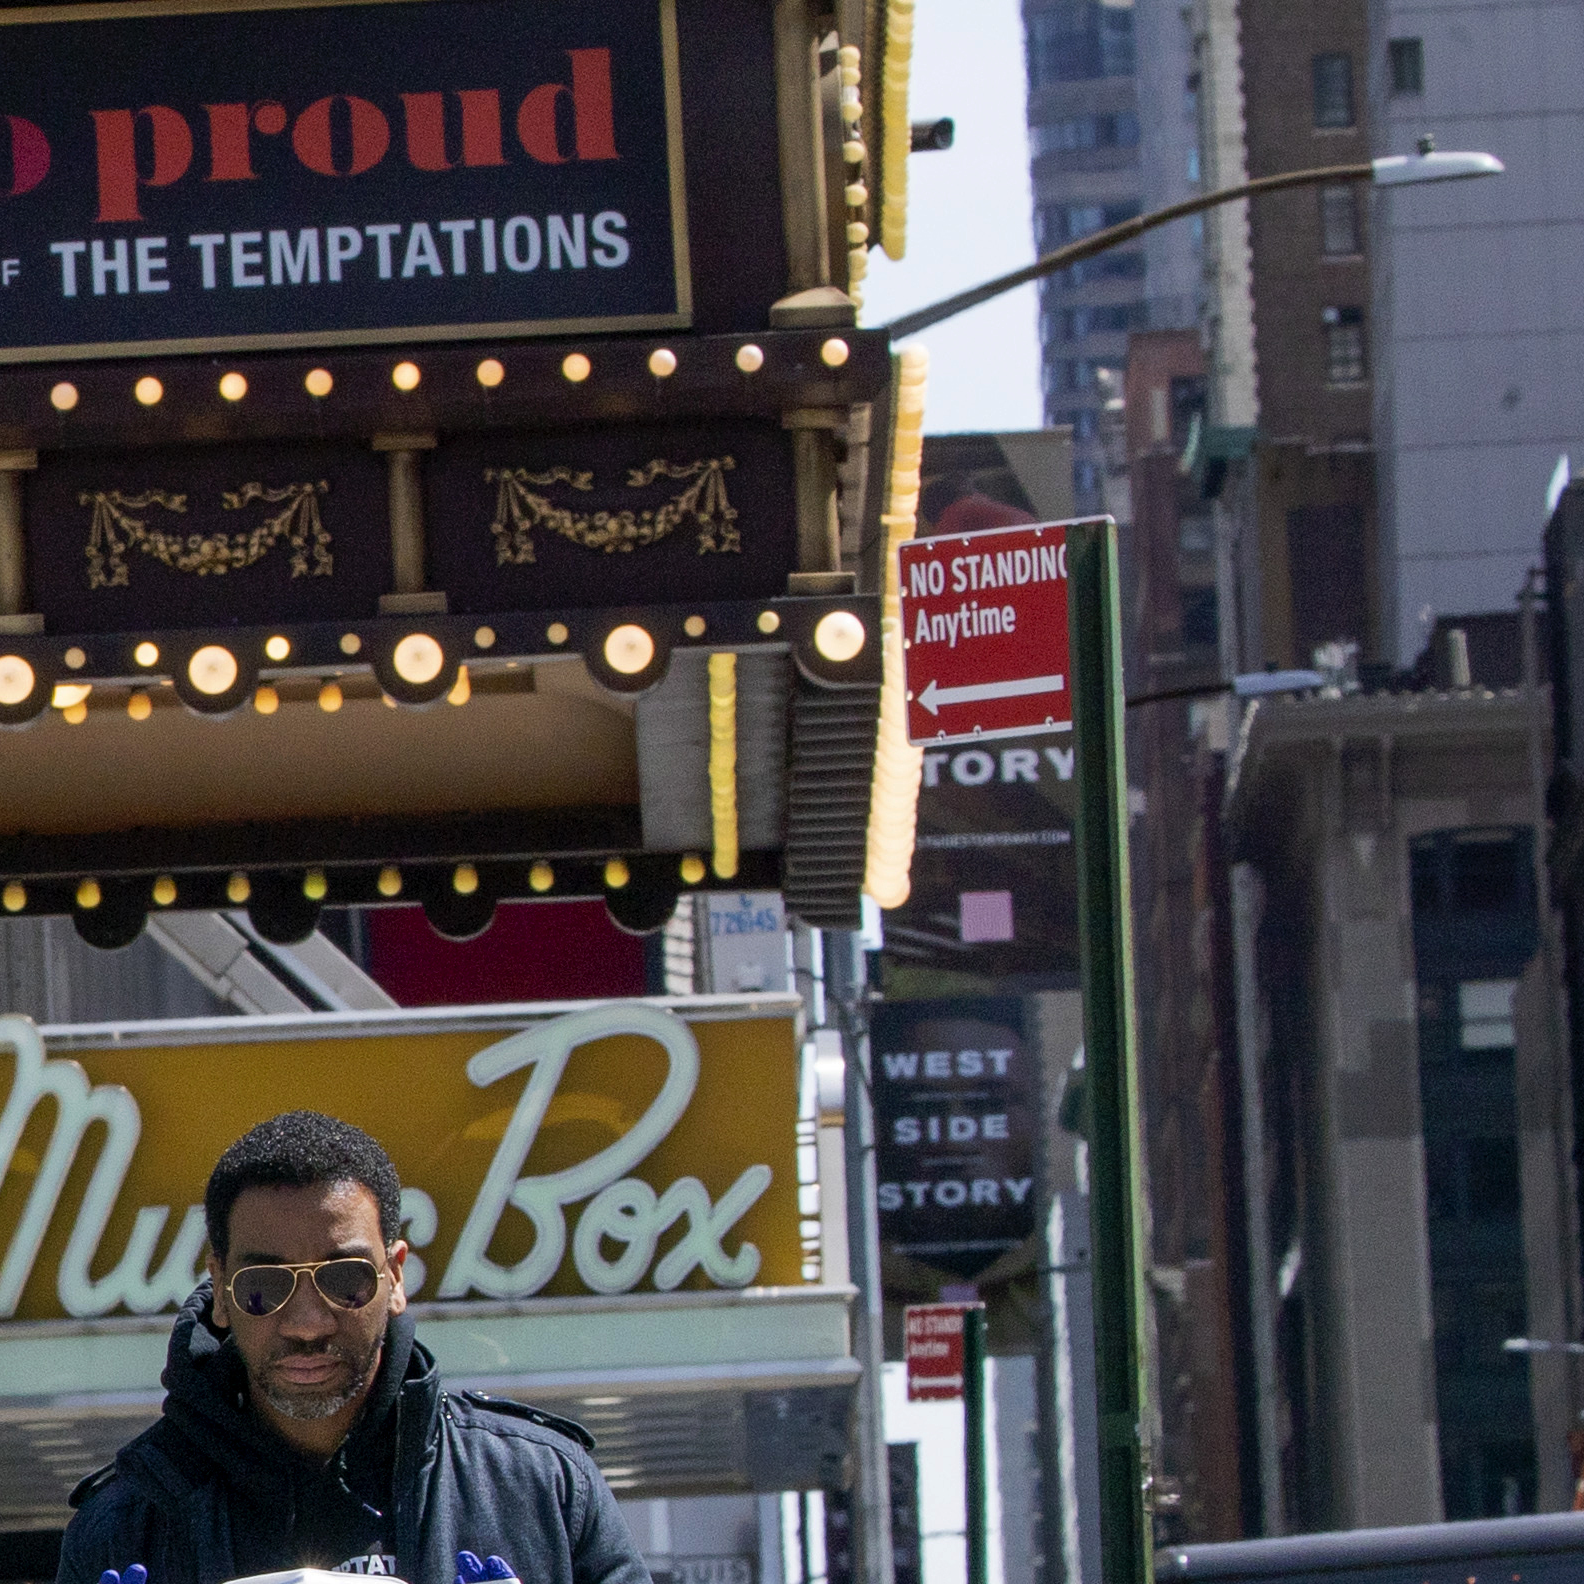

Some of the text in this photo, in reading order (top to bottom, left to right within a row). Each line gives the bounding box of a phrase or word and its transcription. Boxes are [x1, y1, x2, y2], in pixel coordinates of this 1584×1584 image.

[88, 47, 622, 222] proud
[51, 237, 170, 297] THE
[190, 210, 630, 289] TEMPTATIONS
[909, 560, 945, 598] NO
[915, 601, 1016, 648] Anytime
[923, 746, 1074, 788] TORY
[883, 1049, 1013, 1079] WEST
[439, 1002, 773, 1299] Box
[894, 1114, 1010, 1145] SIDE
[878, 1177, 1031, 1211] STORY
